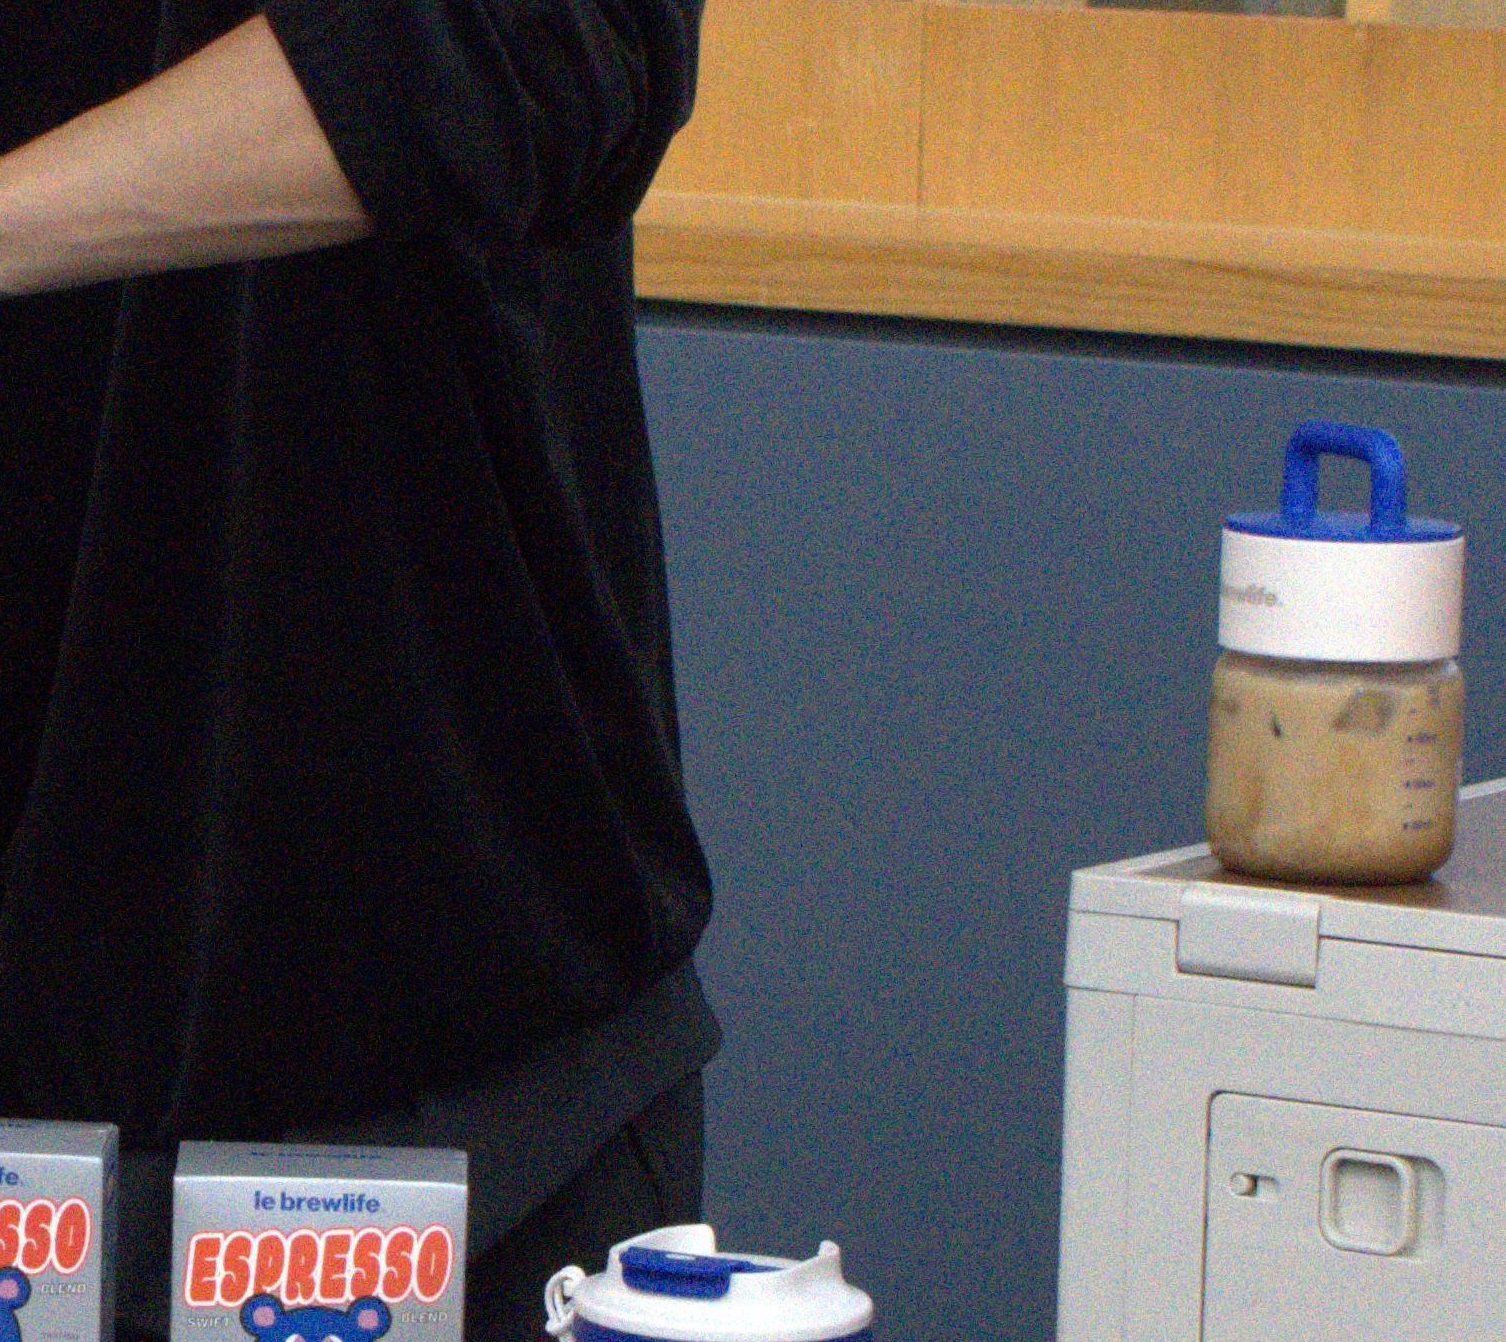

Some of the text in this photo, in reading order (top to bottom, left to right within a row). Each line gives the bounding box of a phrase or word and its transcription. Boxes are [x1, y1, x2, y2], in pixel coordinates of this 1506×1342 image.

[254, 1191, 276, 1210] le
[186, 1225, 453, 1307] ESPRESSO
[401, 1312, 448, 1324] BLEND
